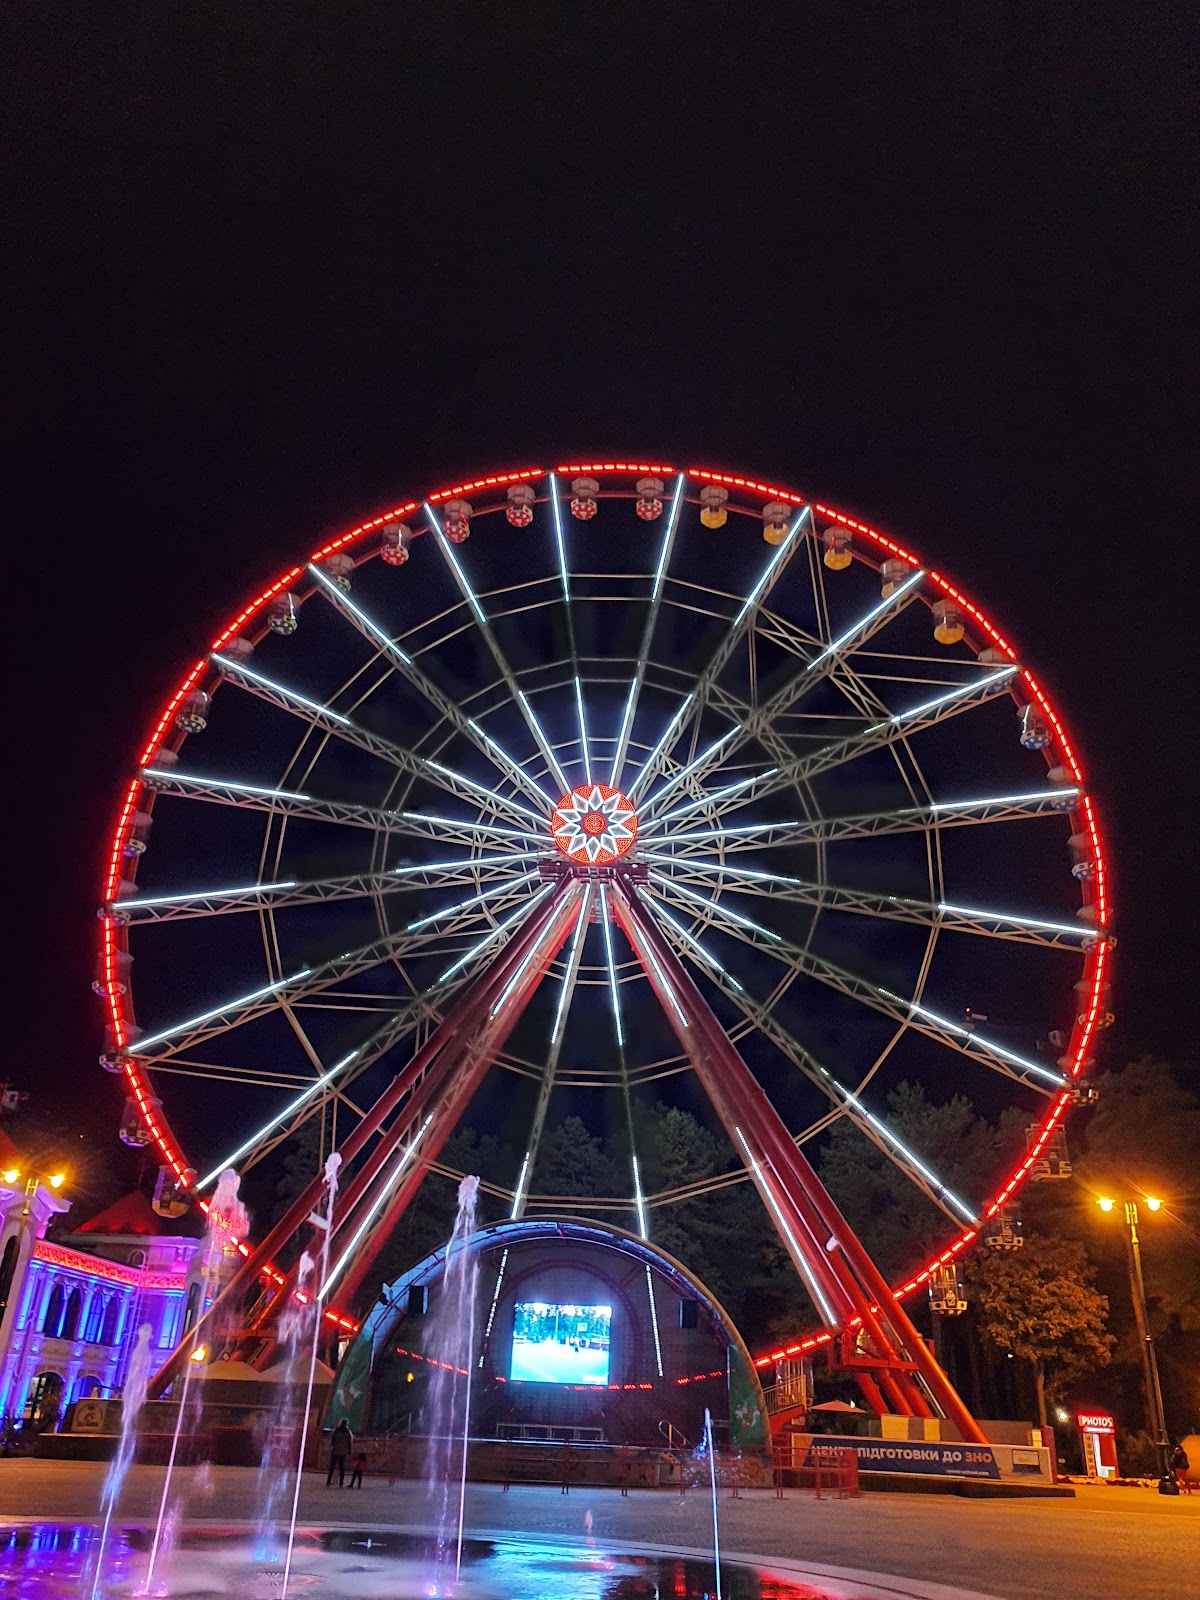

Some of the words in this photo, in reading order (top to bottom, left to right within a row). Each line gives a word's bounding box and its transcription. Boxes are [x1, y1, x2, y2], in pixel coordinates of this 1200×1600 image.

[1081, 1416, 1113, 1427] PHOTOS
[811, 1445, 855, 1457] ЦЕНТ
[857, 1447, 939, 1461] ПІДГОТОВКИ
[942, 1451, 962, 1463] ДО
[965, 1452, 992, 1463] ЗНО
